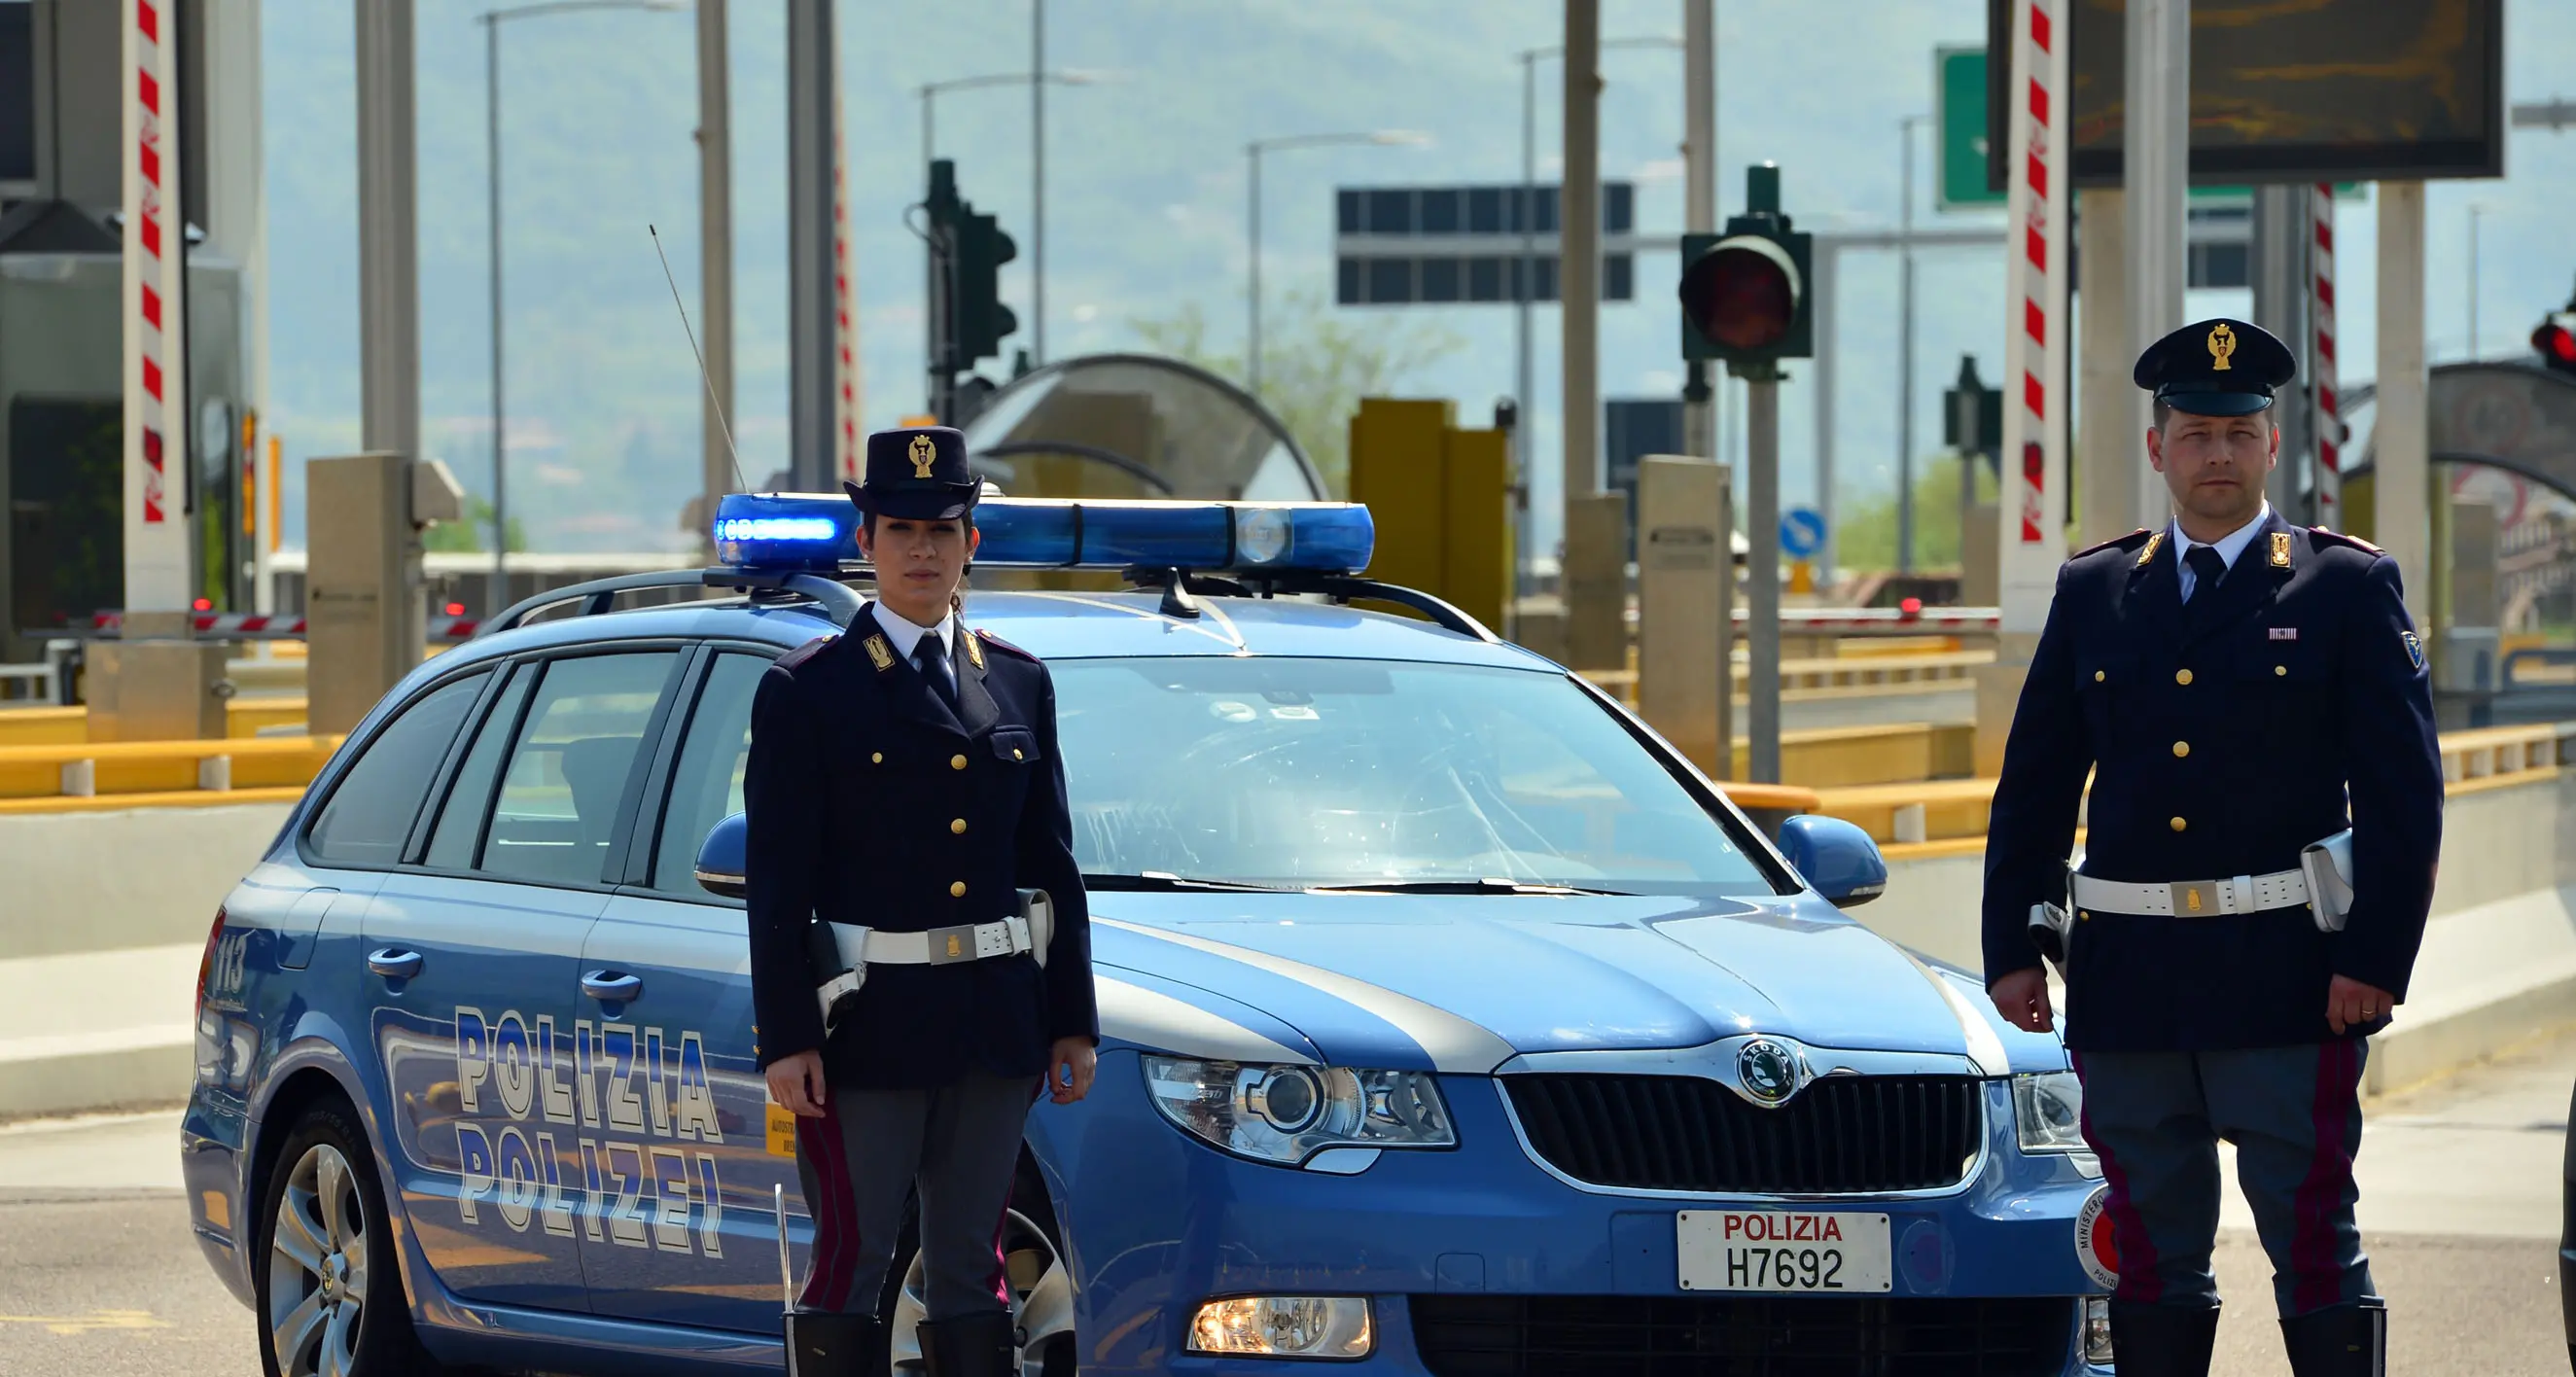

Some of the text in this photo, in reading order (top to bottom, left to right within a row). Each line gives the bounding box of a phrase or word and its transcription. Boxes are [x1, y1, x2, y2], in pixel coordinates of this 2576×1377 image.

[216, 935, 247, 993] 113
[455, 1006, 723, 1143] POLIZIA
[455, 1121, 723, 1259] POLIZEI
[1724, 1215, 1843, 1241] POLIZIA
[2080, 1194, 2104, 1249] MINISTERO
[1727, 1248, 1843, 1288] H7692
